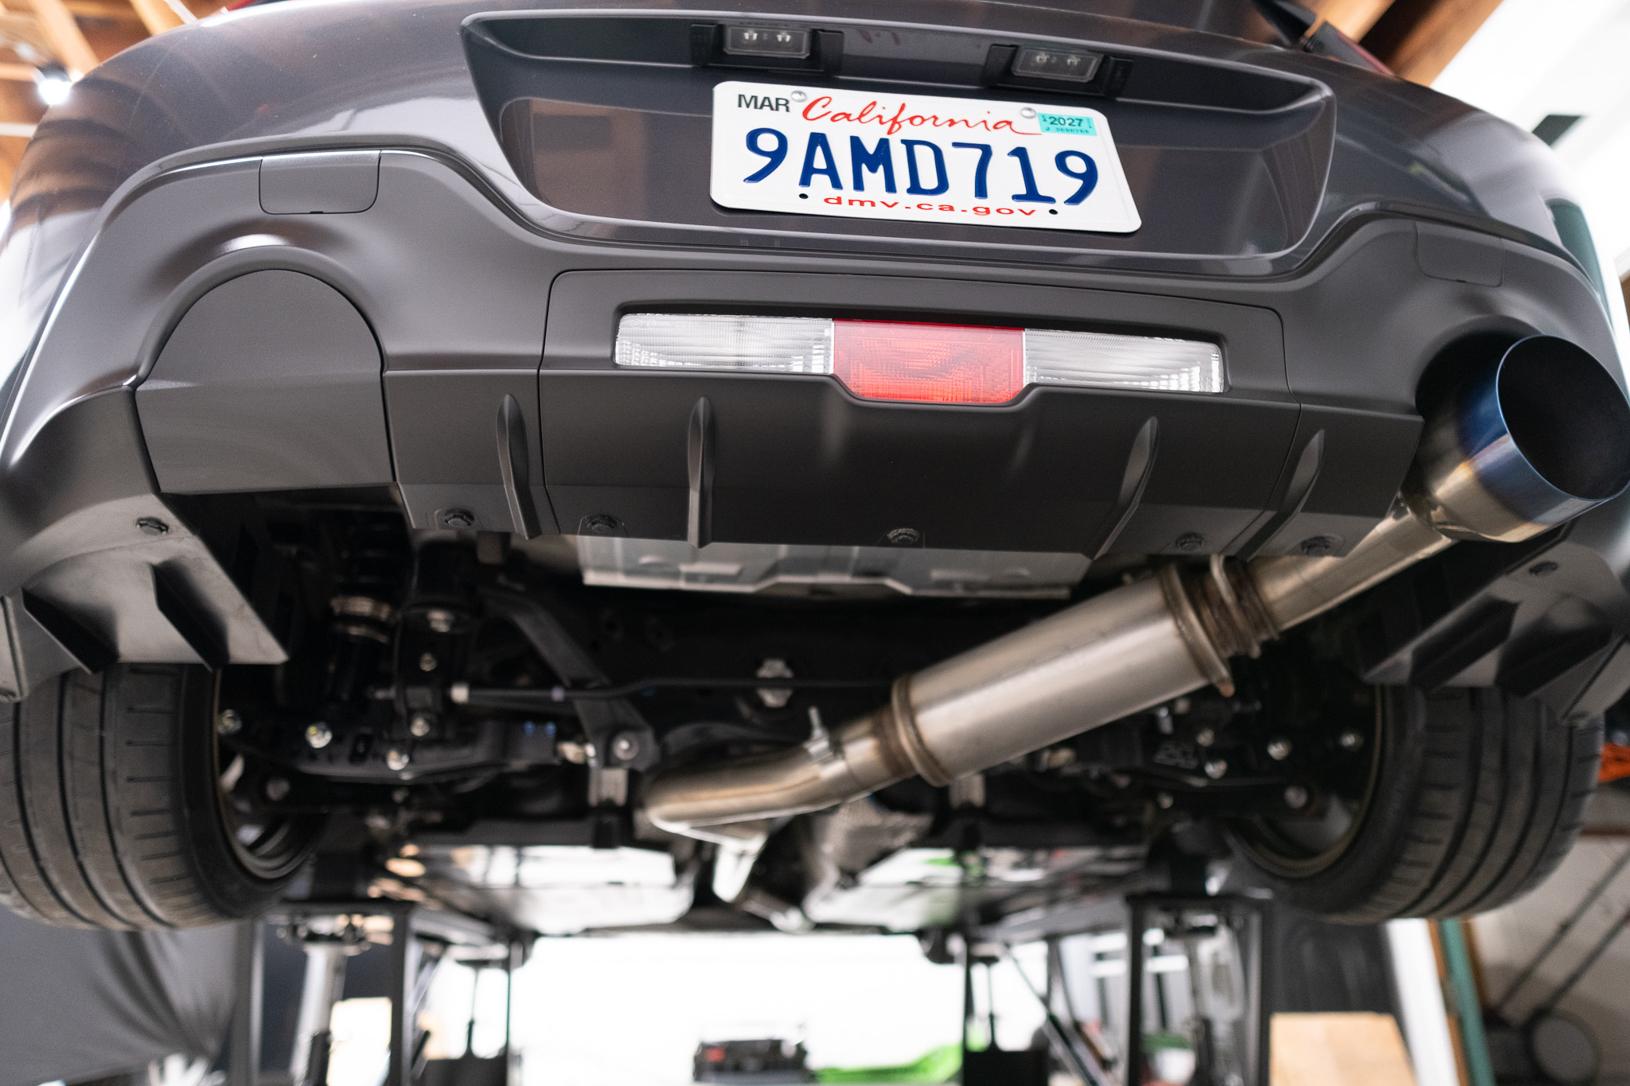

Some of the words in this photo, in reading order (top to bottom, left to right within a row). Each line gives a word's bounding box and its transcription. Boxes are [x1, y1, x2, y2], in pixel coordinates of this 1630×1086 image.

[737, 93, 790, 113] MAR
[802, 95, 1042, 136] California
[1048, 115, 1083, 128] 2027
[743, 127, 1099, 206] 9AMD719
[823, 195, 1037, 217] dmv.ca.gov
